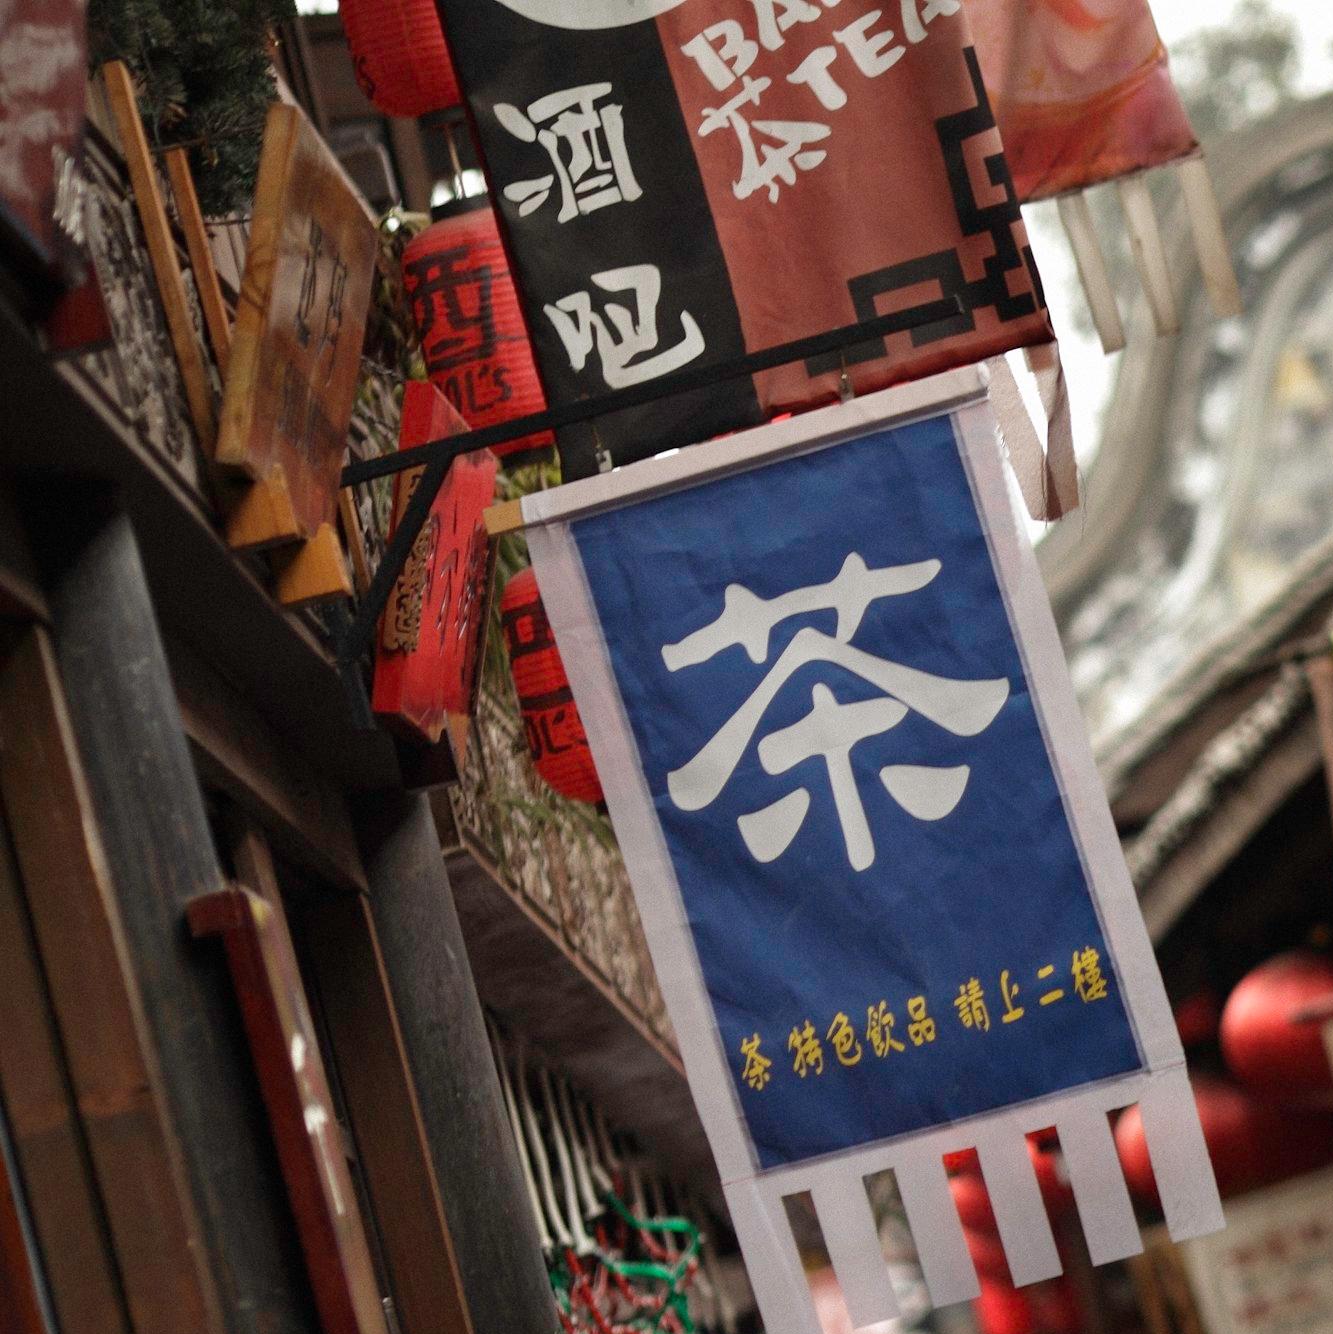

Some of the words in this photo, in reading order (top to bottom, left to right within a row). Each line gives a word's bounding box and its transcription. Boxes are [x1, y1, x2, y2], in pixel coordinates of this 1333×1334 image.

[681, 0, 842, 92] BA
[493, 82, 706, 389] 酒吧
[661, 551, 1010, 873] 茶
